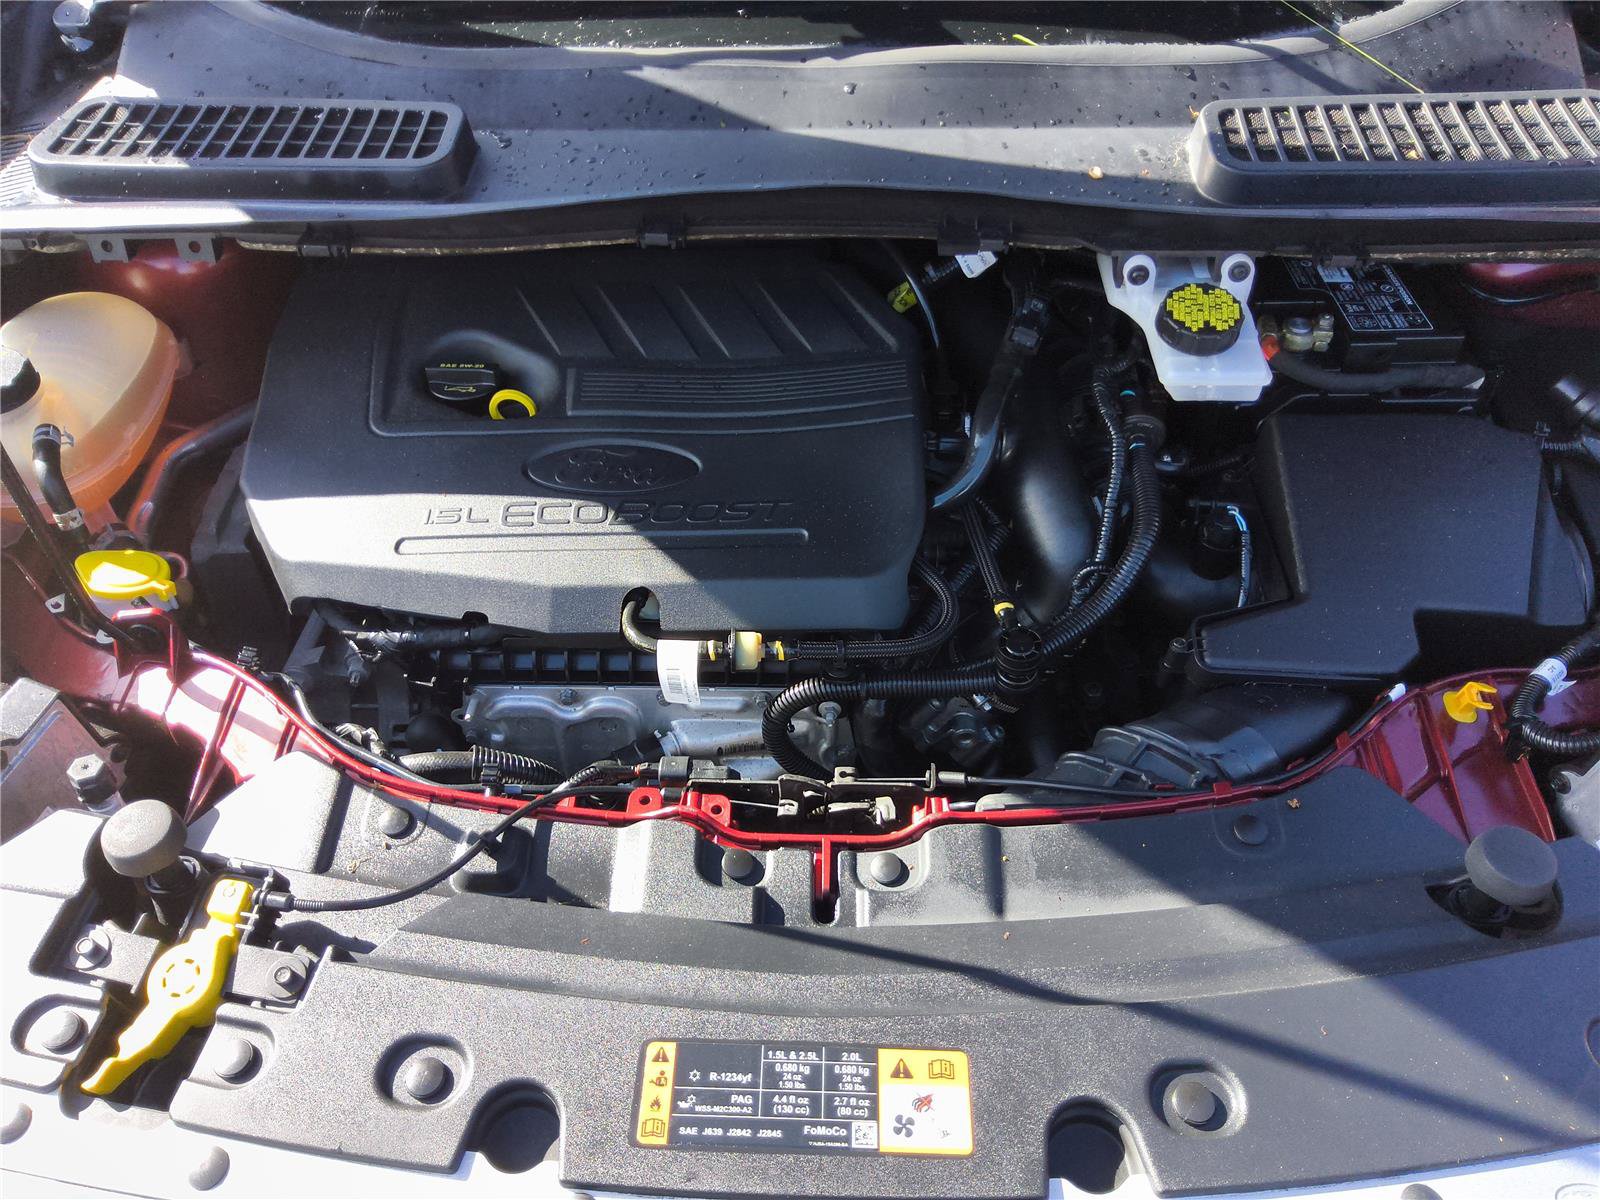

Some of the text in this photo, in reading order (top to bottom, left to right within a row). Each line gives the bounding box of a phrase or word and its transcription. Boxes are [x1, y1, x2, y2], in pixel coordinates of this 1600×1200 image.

[501, 500, 793, 527] ECOBOOST
[768, 1050, 819, 1061] 1.5L & 2.5L
[841, 1052, 863, 1061] 2.0L
[775, 1063, 810, 1074] 0.680 kg
[834, 1065, 870, 1076] 0.680 kg
[709, 1071, 753, 1083] R-1234yf
[854, 1083, 866, 1091] lbs
[731, 1095, 753, 1105] PAG
[772, 1095, 787, 1103] 4.4
[788, 1095, 796, 1103] fl
[834, 1097, 849, 1106] 2.7
[849, 1097, 857, 1106] fl
[695, 1105, 753, 1114] WSS-M2C300-A2
[773, 1105, 810, 1116] (130 cc)
[837, 1107, 868, 1118] (80 cc)
[679, 1127, 783, 1138] SAE J639 J2842 J2845
[803, 1125, 847, 1136] FoMoCo
